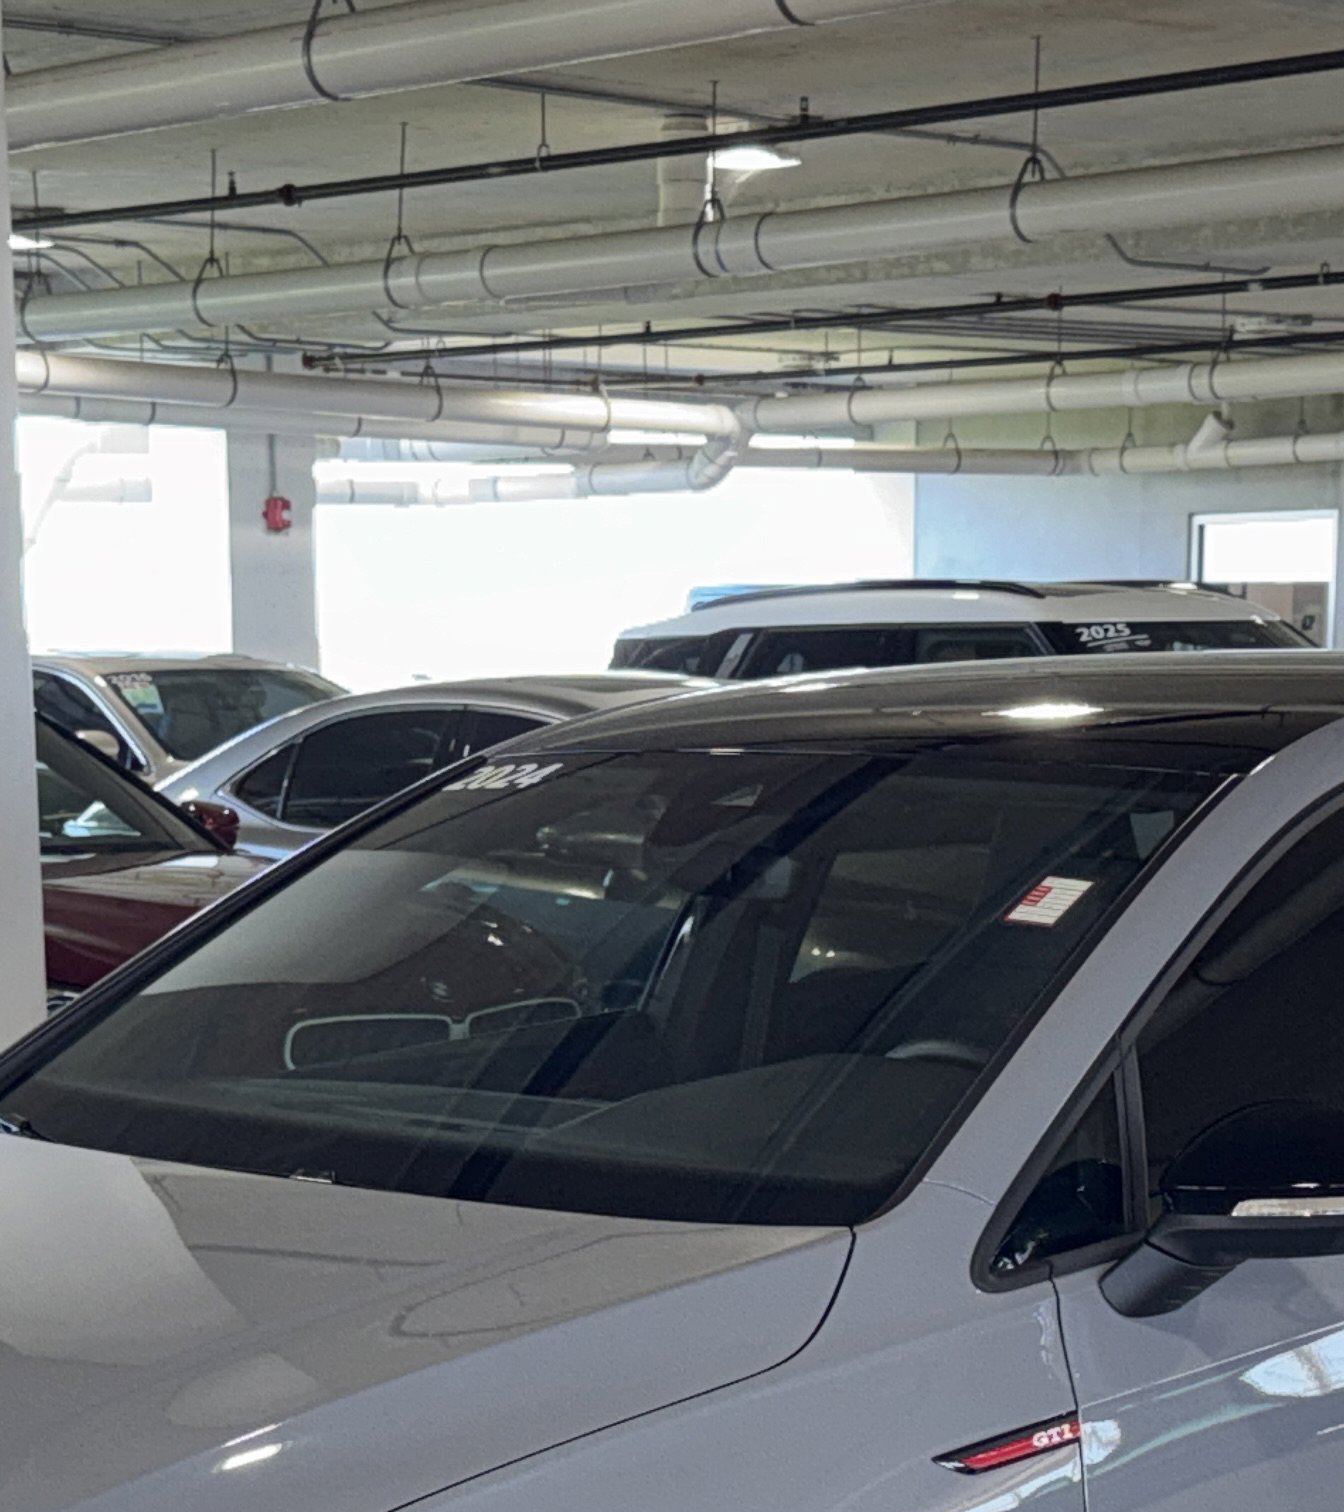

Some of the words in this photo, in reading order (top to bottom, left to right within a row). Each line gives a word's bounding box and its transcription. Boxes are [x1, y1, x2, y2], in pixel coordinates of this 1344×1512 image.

[1075, 622, 1131, 642] 2025
[441, 763, 564, 791] 2024
[1032, 1423, 1074, 1449] GTI
